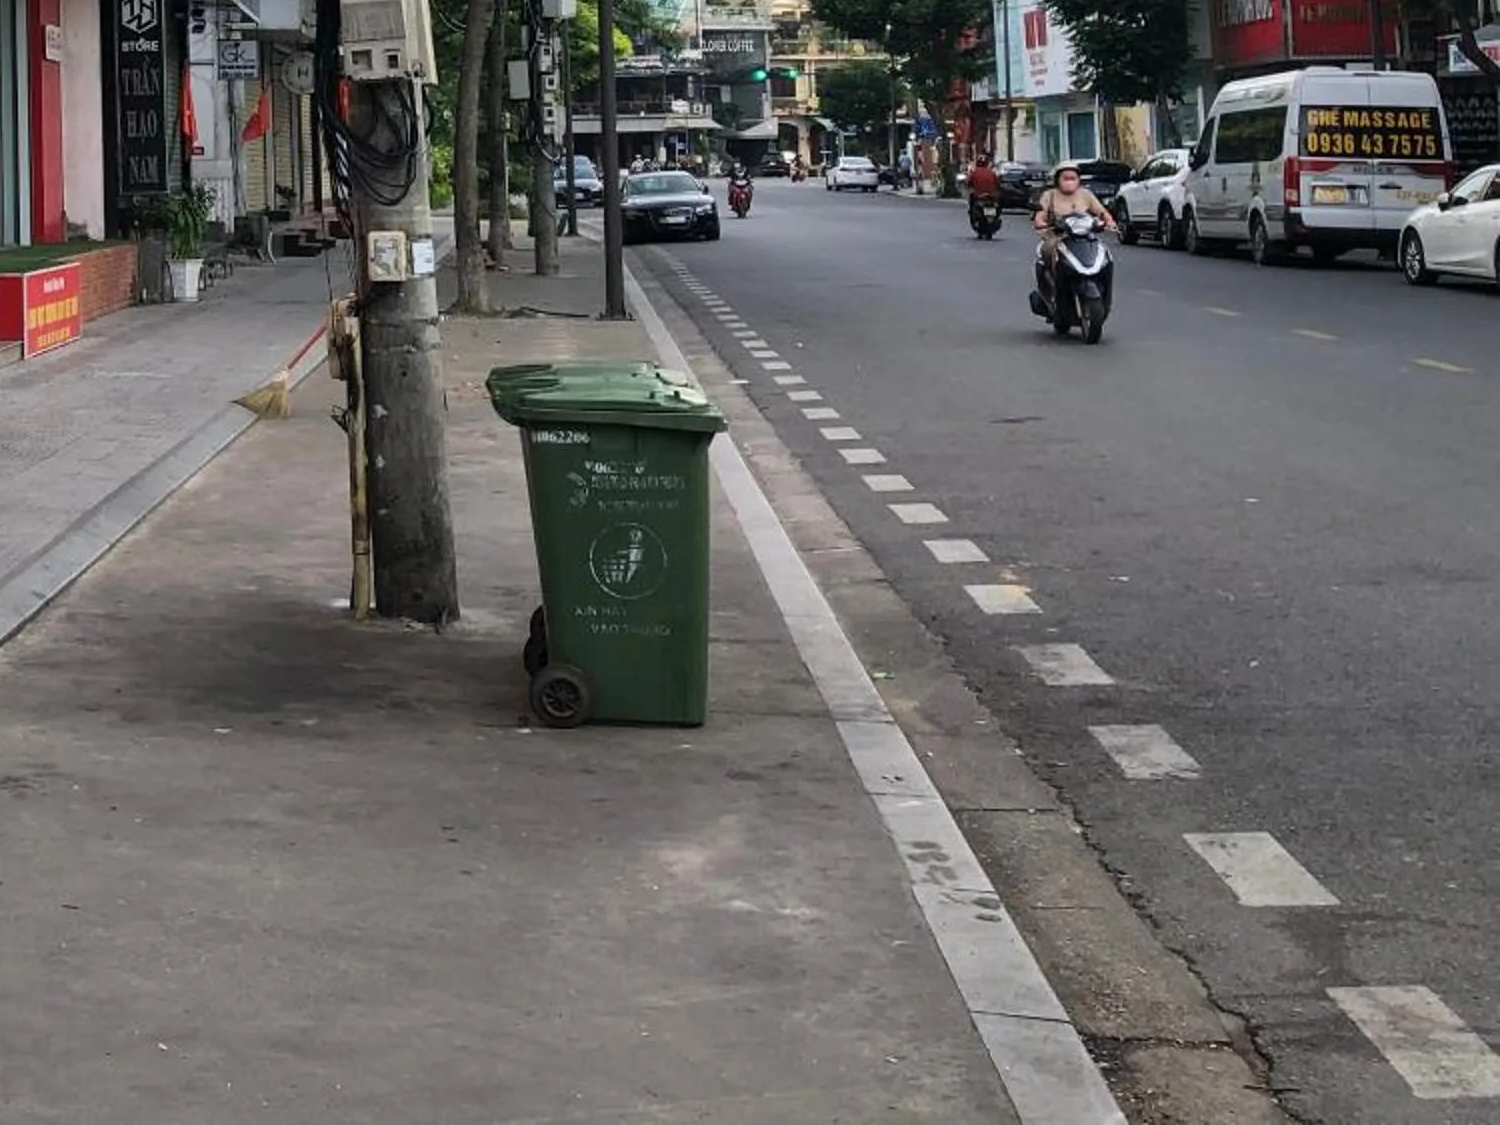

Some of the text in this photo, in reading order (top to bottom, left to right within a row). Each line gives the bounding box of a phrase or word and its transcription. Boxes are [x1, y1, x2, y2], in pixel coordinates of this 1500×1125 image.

[121, 38, 160, 52] STORE
[1343, 110, 1432, 128] MASSAGE
[1307, 132, 1436, 156] 0936 43 7575
